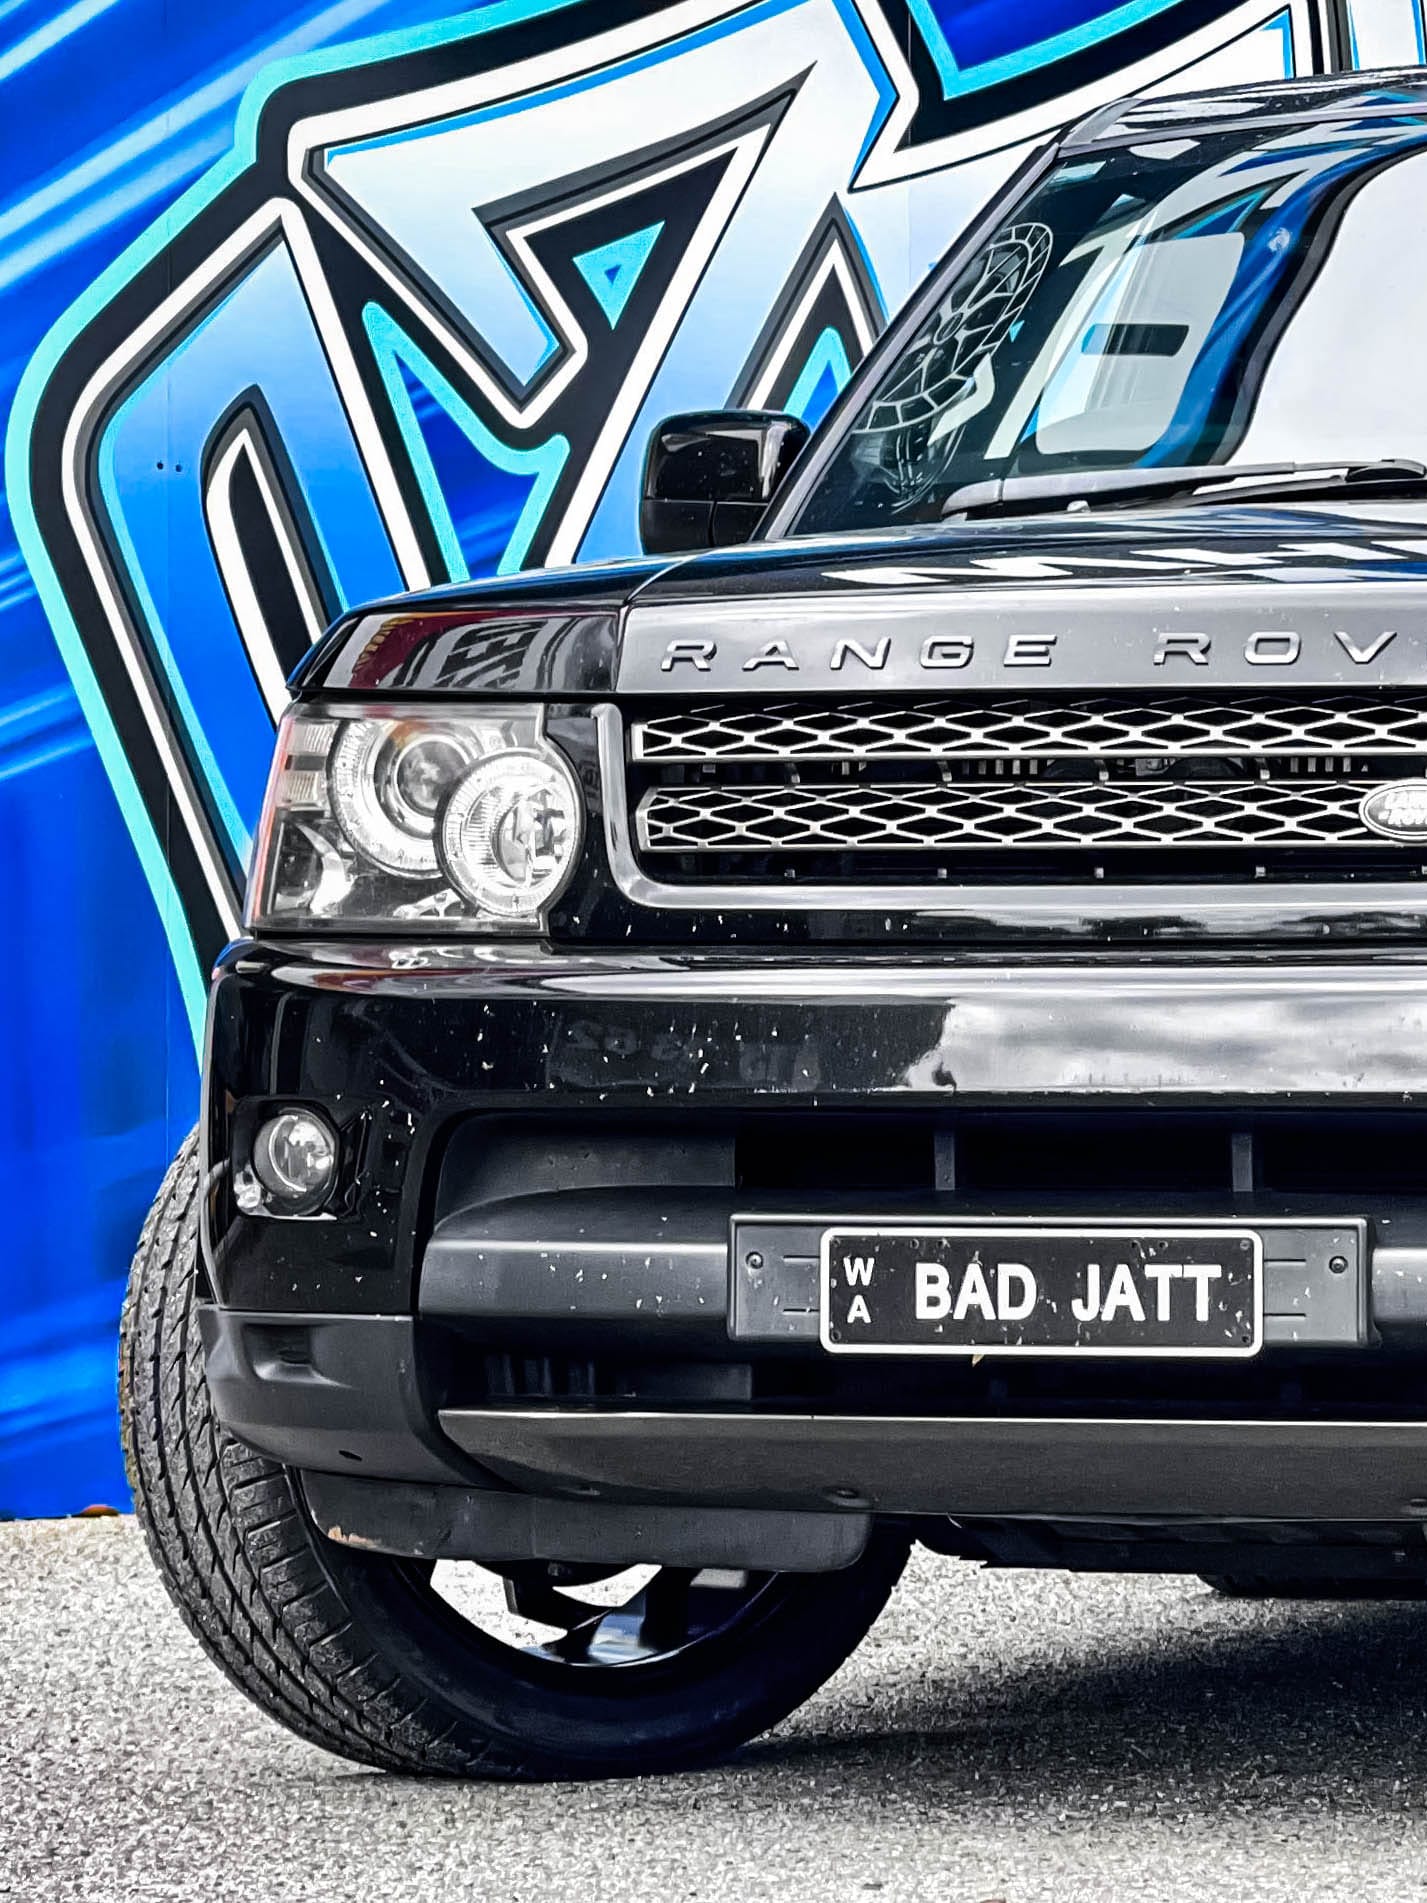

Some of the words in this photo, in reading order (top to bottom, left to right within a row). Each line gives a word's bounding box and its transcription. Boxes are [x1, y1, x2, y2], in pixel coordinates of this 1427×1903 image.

[660, 633, 1058, 672] RANGE
[914, 1262, 1038, 1321] BAD
[1071, 1263, 1223, 1322] JATT
